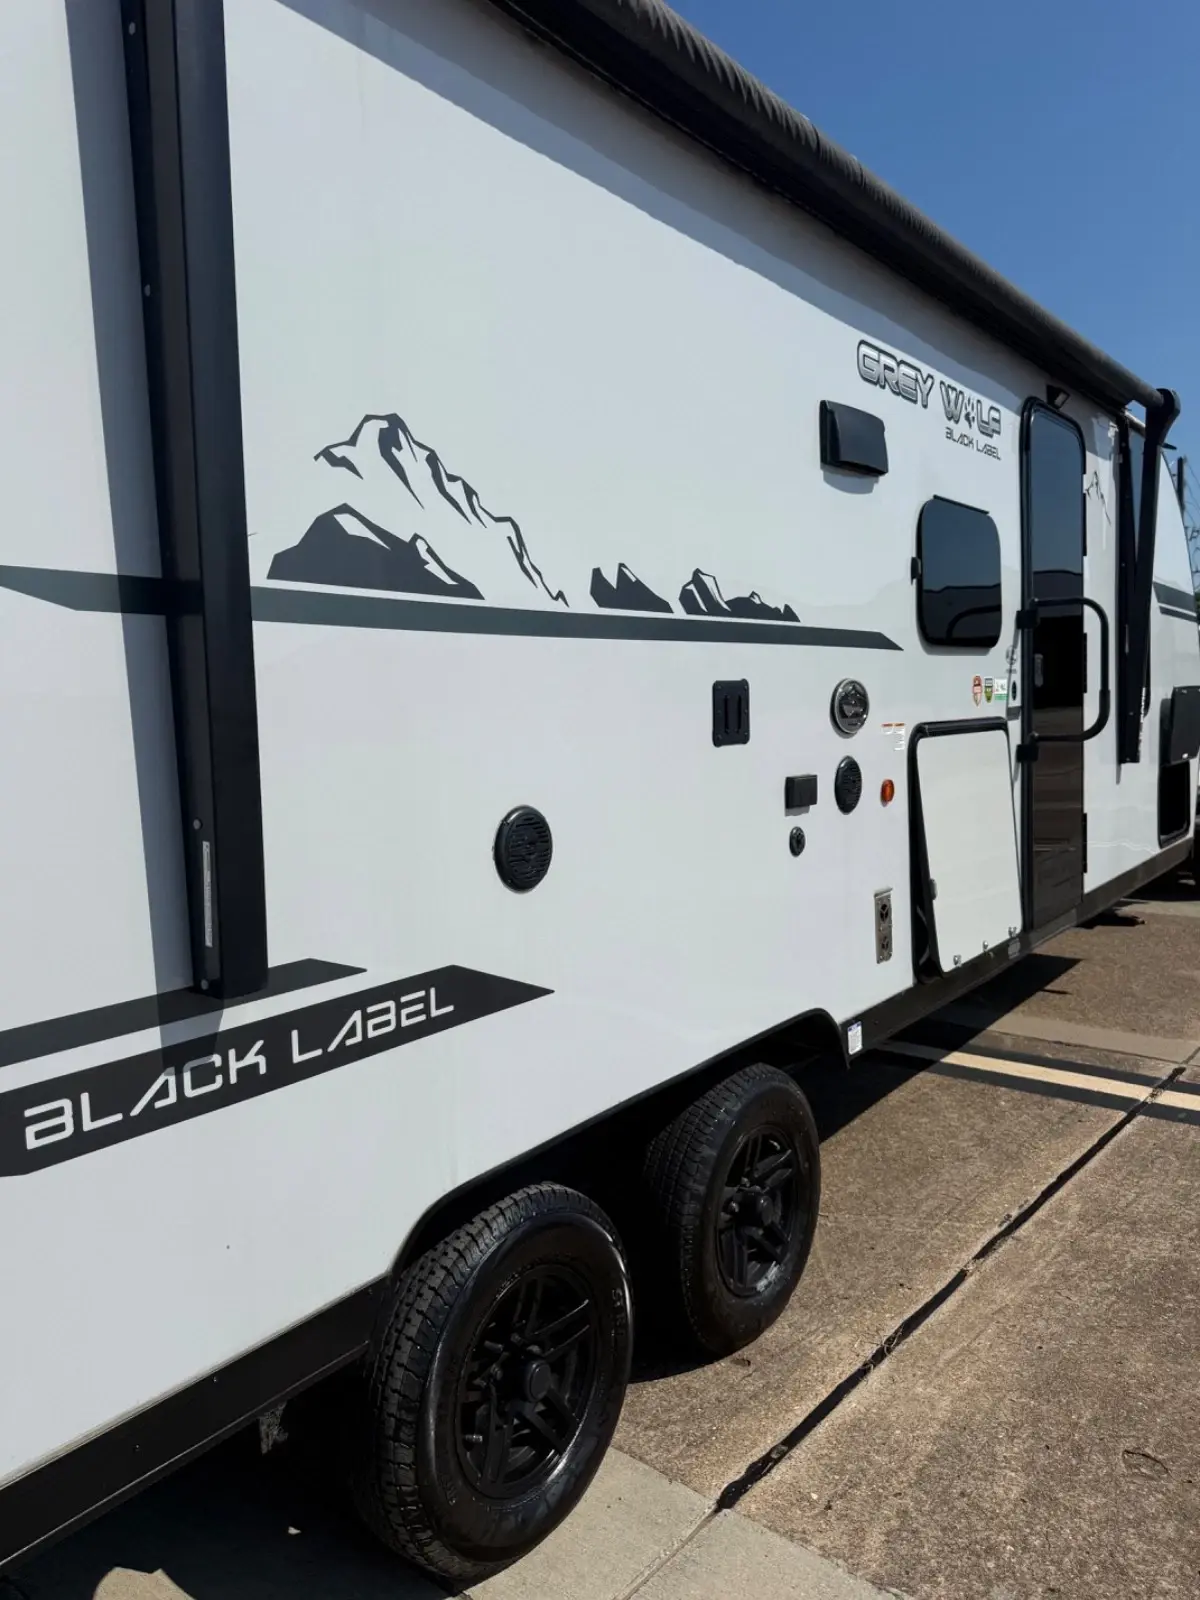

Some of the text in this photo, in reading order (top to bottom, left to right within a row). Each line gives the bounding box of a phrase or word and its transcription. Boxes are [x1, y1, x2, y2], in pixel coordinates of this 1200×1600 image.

[857, 339, 934, 409] GREY
[945, 426, 1002, 461] BLACK LABEL
[24, 986, 454, 1151] BLACK LABEL
